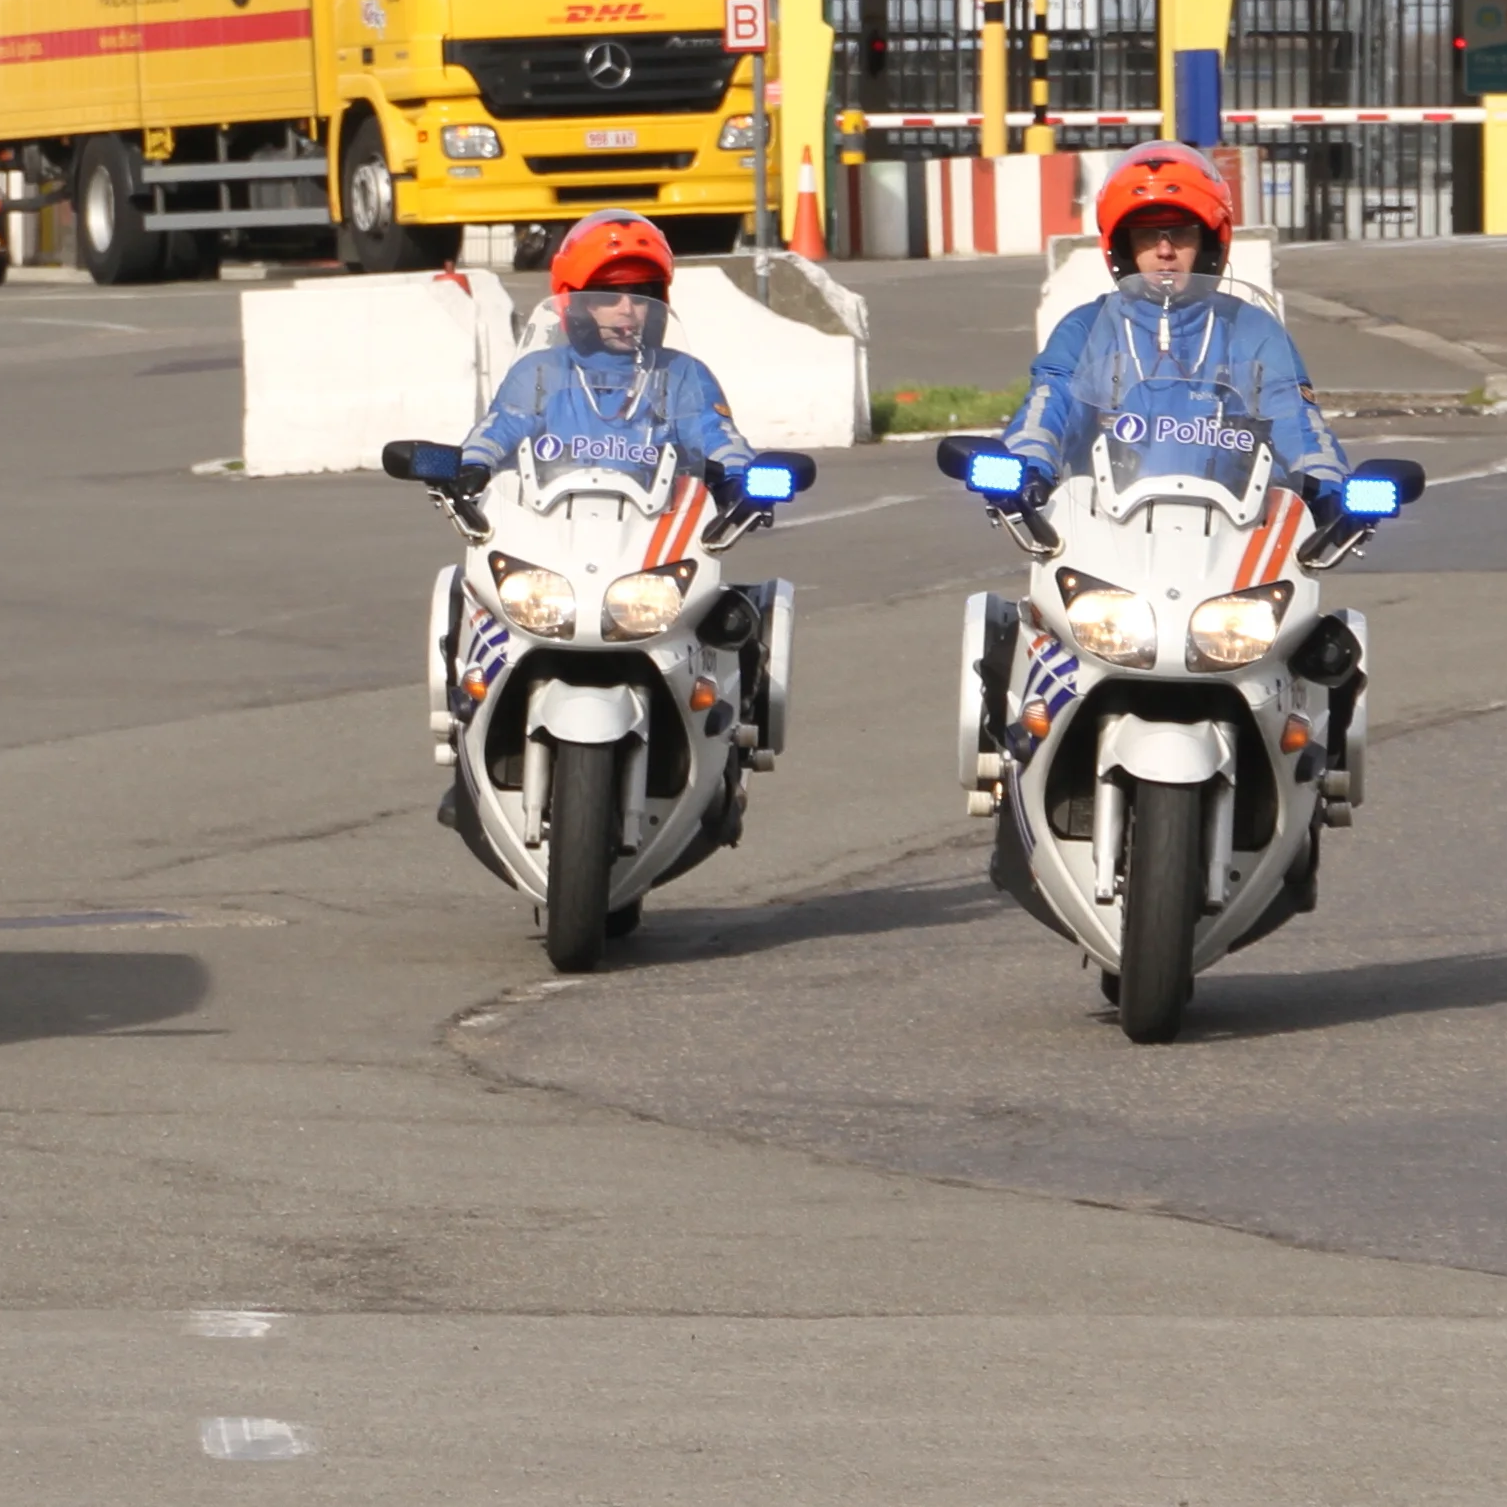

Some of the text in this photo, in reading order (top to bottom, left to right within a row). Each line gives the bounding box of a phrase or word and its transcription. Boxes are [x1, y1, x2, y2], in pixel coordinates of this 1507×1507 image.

[564, 3, 649, 23] DHL
[734, 4, 758, 40] B
[572, 434, 659, 464] Police
[1156, 416, 1254, 451] Police
